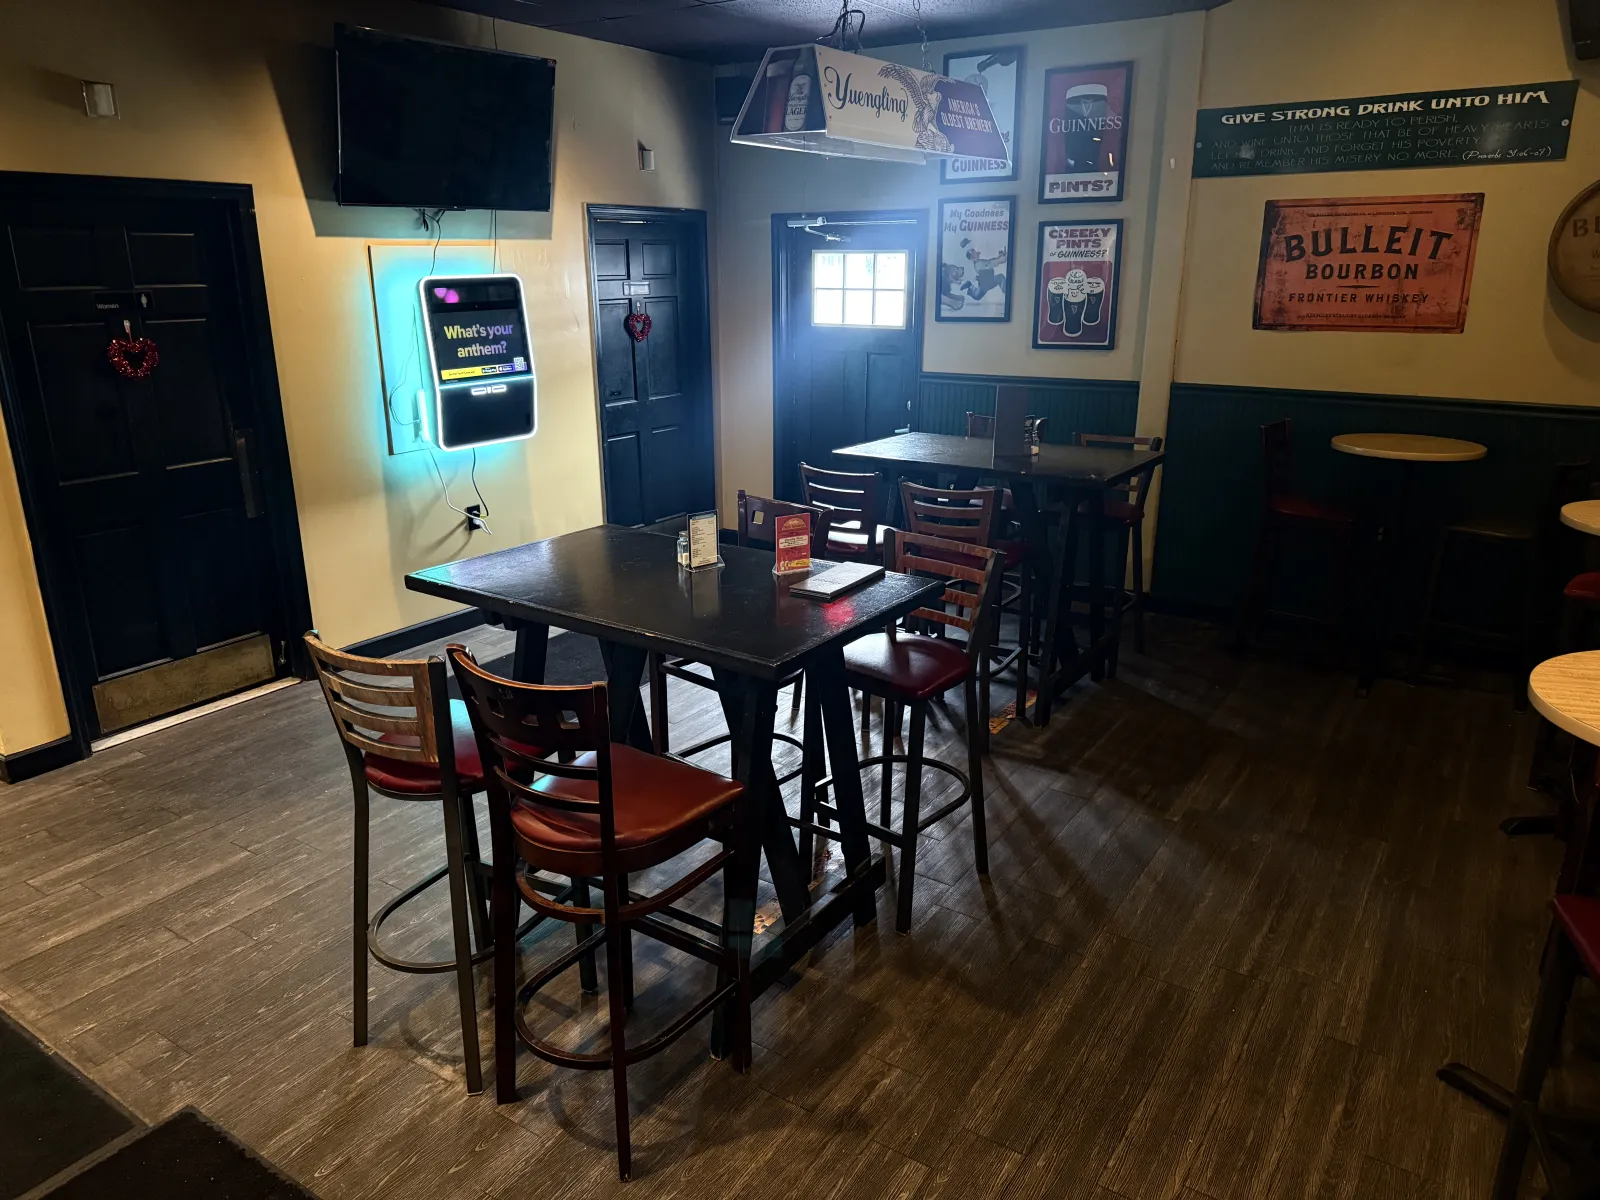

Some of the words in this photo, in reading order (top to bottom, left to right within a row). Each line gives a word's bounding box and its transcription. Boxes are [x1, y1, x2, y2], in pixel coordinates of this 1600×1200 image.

[824, 66, 909, 123] Yuengling
[947, 97, 981, 117] AMERICA'S
[1221, 112, 1266, 125] GIVE
[1271, 105, 1351, 121] STRONG
[1357, 100, 1425, 116] DRINK
[1431, 95, 1490, 110] UNTO
[1497, 90, 1550, 105] HIM
[940, 111, 965, 129] OLDEST
[965, 117, 993, 133] BREWERY
[1049, 115, 1123, 134] GUINNESS
[1288, 124, 1314, 134] THAT
[1318, 121, 1332, 131] IS
[1336, 119, 1380, 131] READY
[1384, 117, 1406, 127] TO
[1212, 140, 1237, 149] AND
[1241, 137, 1271, 147] WINE
[1273, 135, 1309, 145] UNTO
[1315, 132, 1356, 143] THOSE
[1363, 129, 1392, 140] THAT
[1397, 128, 1412, 138] BE
[1418, 126, 1438, 136] OF
[1444, 122, 1490, 134] HEAVY
[1211, 151, 1229, 160] LET
[1303, 145, 1330, 154] AND
[1334, 141, 1386, 152] FORGET
[1391, 140, 1412, 149] HIS
[952, 158, 1007, 173] GUINNESS
[1211, 161, 1236, 170] AND
[1239, 157, 1306, 169] REMEMBER
[1310, 155, 1331, 165] HIS
[1335, 153, 1383, 163] MISERY
[1387, 151, 1410, 161] NO
[1048, 179, 1115, 194] PINTS?
[950, 208, 963, 220] My
[964, 208, 1005, 219] Goodness
[944, 221, 957, 234] My
[959, 219, 1009, 232] GUINNESS
[1048, 228, 1112, 239] CHEEKY
[1056, 239, 1102, 249] PINTS
[1284, 225, 1454, 263] BULLEIT
[1058, 249, 1108, 258] GUINNESS?
[1305, 263, 1419, 281] BOURBON
[1289, 293, 1358, 303] FRONTIER
[1366, 293, 1430, 304] WHISKEY
[443, 324, 486, 340] What's
[487, 324, 514, 340] your
[457, 340, 507, 358] anthem?
